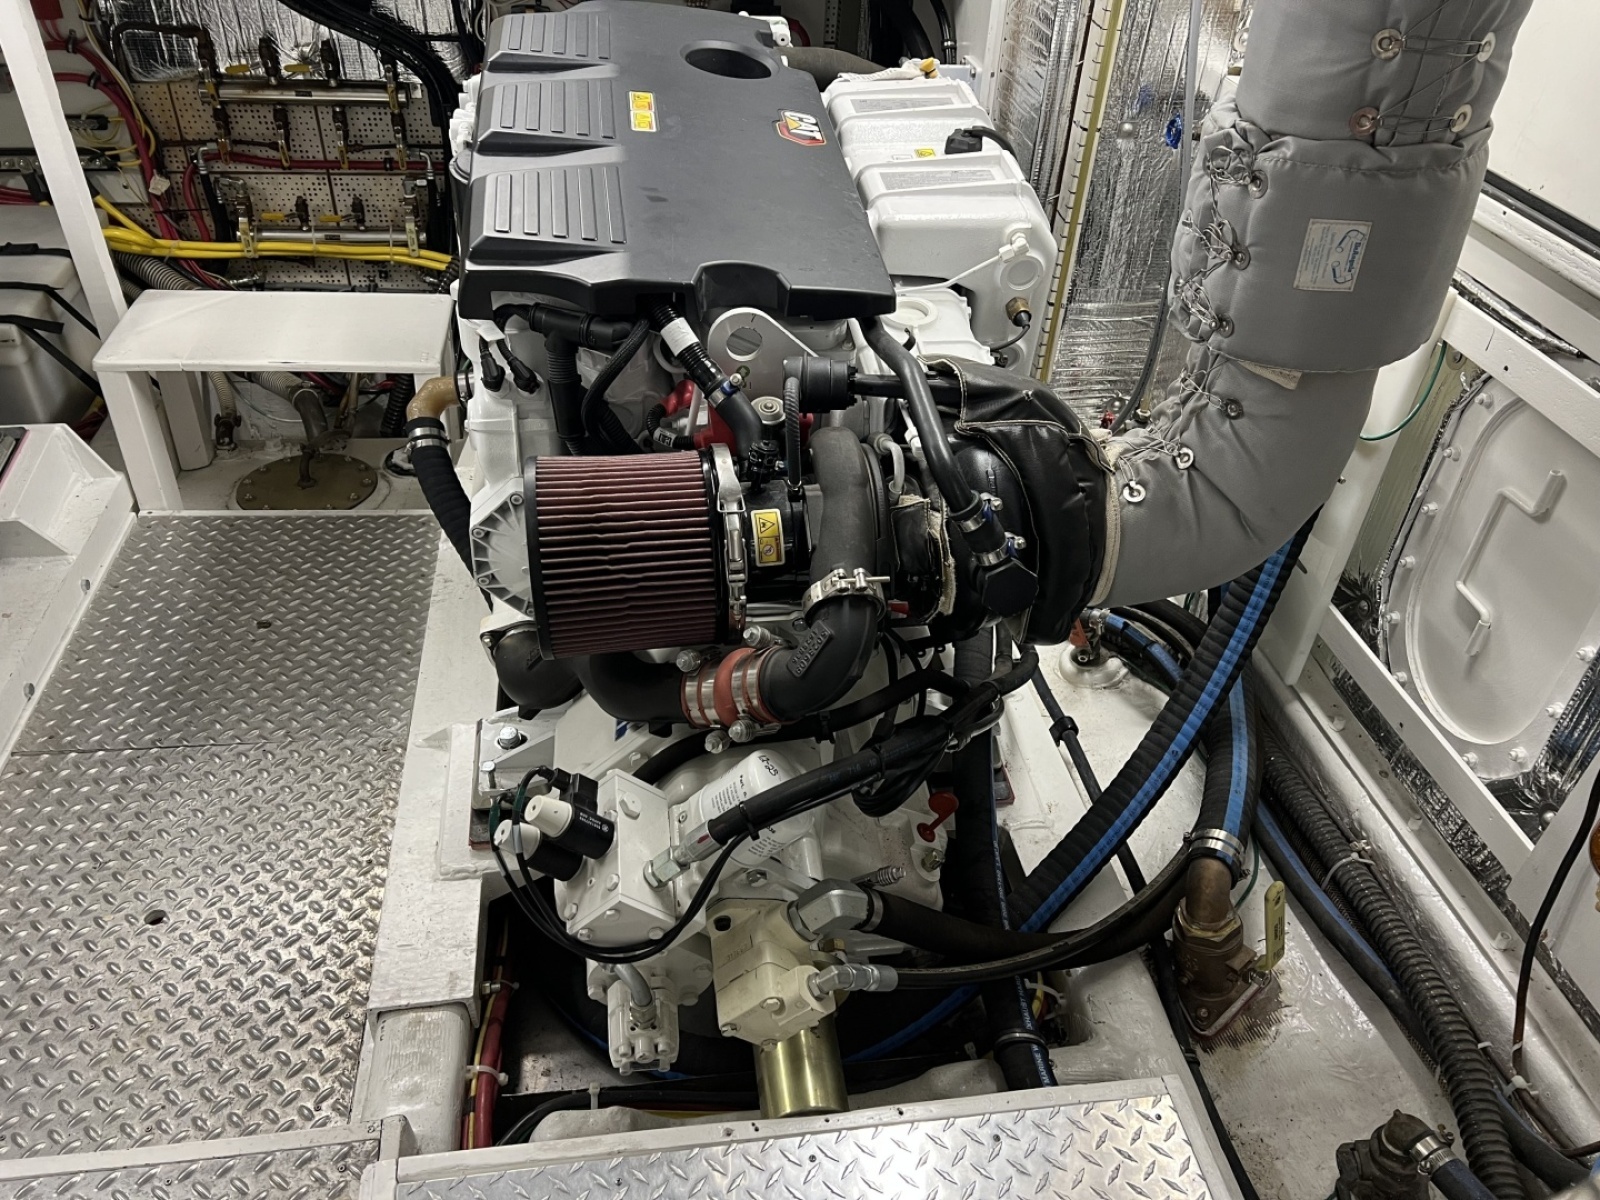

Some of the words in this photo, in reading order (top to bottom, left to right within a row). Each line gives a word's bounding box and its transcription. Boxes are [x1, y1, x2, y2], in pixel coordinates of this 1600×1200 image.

[784, 111, 823, 141] CAT
[1020, 997, 1033, 1030] EXHAUST
[1034, 1051, 1051, 1084] MARINE
